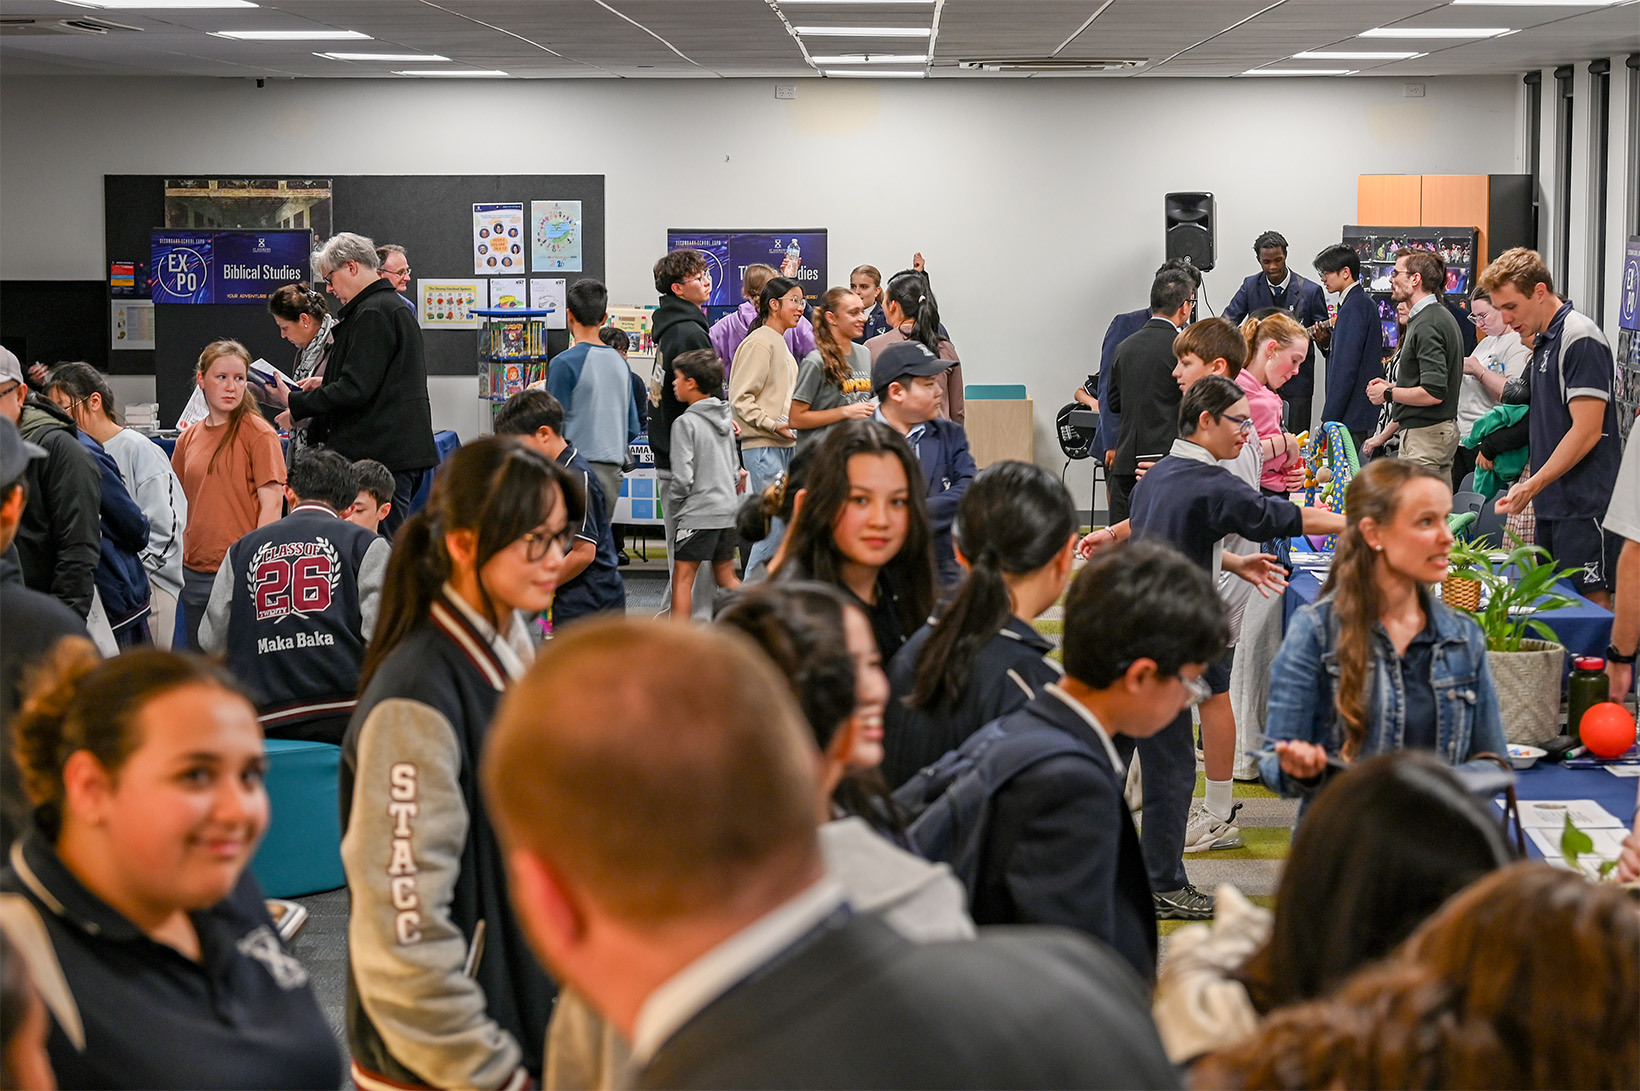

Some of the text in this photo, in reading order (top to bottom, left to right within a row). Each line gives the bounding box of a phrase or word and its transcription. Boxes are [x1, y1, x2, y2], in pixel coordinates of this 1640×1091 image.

[168, 253, 188, 272] EX
[223, 264, 301, 280] Biblical Studies
[177, 273, 197, 291] PO
[630, 446, 650, 454] AMA
[263, 542, 321, 562] CLASS OF
[255, 554, 332, 621] 26
[257, 631, 335, 654] Maka Baka
[387, 761, 422, 946] STACC
